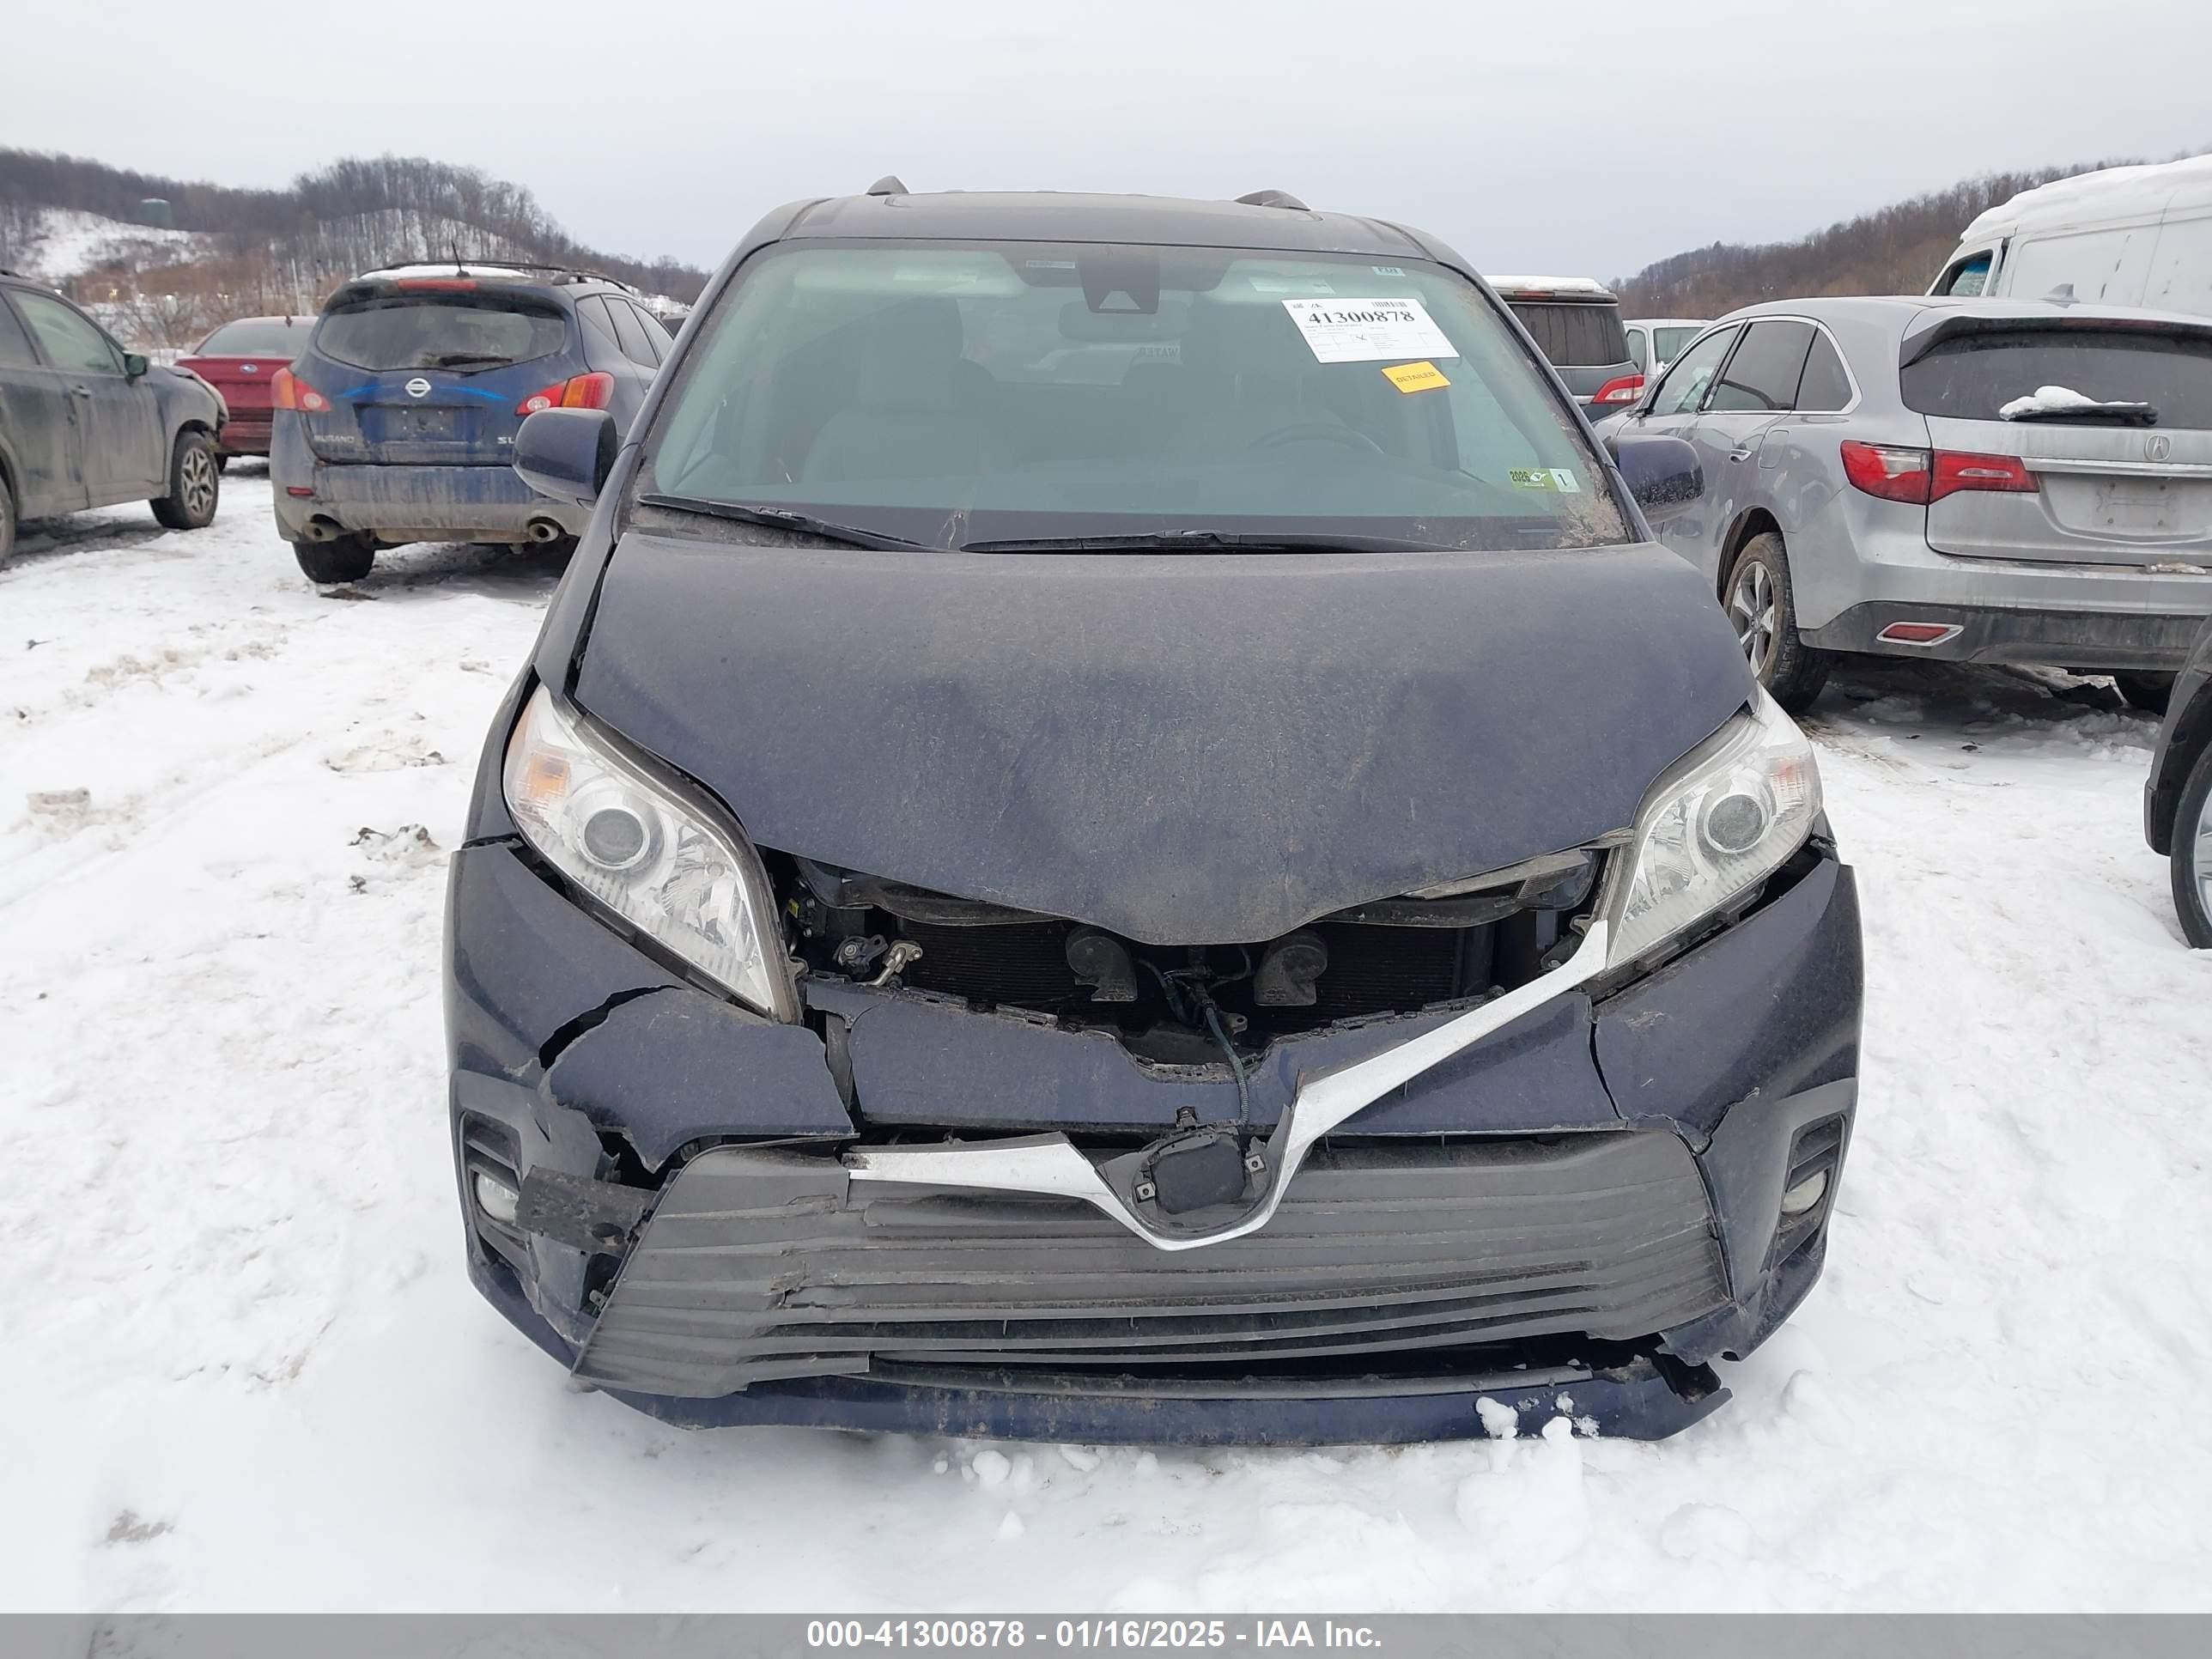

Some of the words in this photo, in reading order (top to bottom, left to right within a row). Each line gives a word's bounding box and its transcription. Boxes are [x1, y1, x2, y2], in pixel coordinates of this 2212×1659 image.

[1308, 310, 1415, 324] 41300878
[1395, 371, 1437, 383] DETAILED
[497, 436, 515, 445] SL
[1557, 473, 1568, 487] 1
